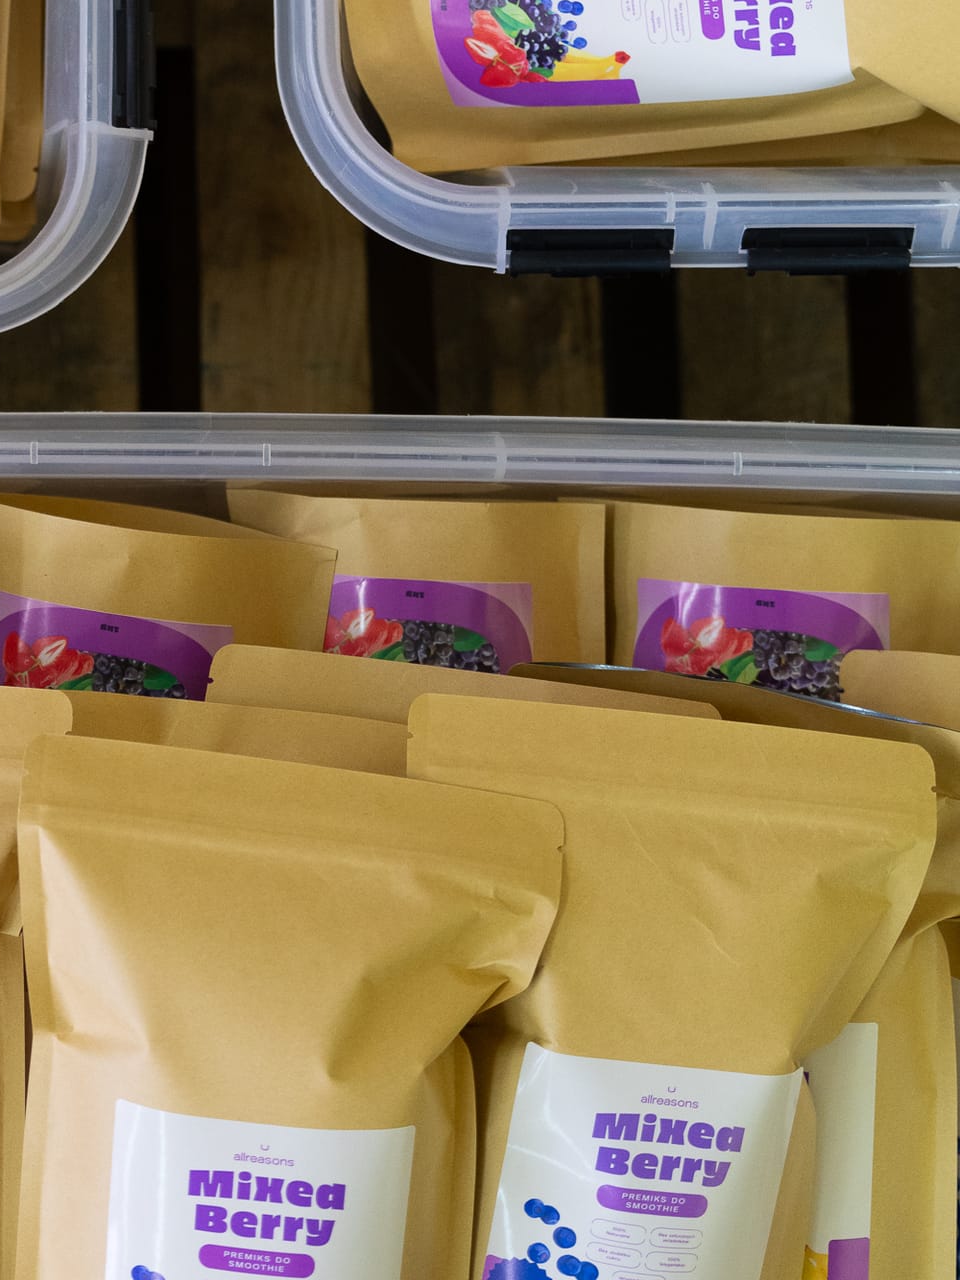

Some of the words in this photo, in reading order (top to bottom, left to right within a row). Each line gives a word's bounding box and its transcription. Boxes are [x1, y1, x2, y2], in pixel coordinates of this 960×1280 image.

[712, 4, 720, 20] DO
[640, 1094, 699, 1109] allreasons
[592, 1112, 745, 1153] Mixed
[233, 1152, 295, 1167] allreasons
[595, 1146, 732, 1188] Berry
[187, 1169, 346, 1211] Mixed
[621, 1192, 667, 1204] PREMIKS
[671, 1197, 686, 1205] DO
[625, 1201, 680, 1214] SMOOTHIE
[194, 1204, 336, 1247] Berry
[223, 1250, 271, 1263] PREMIKS
[275, 1256, 291, 1264] DO
[228, 1260, 285, 1273] SMOOTHIE
